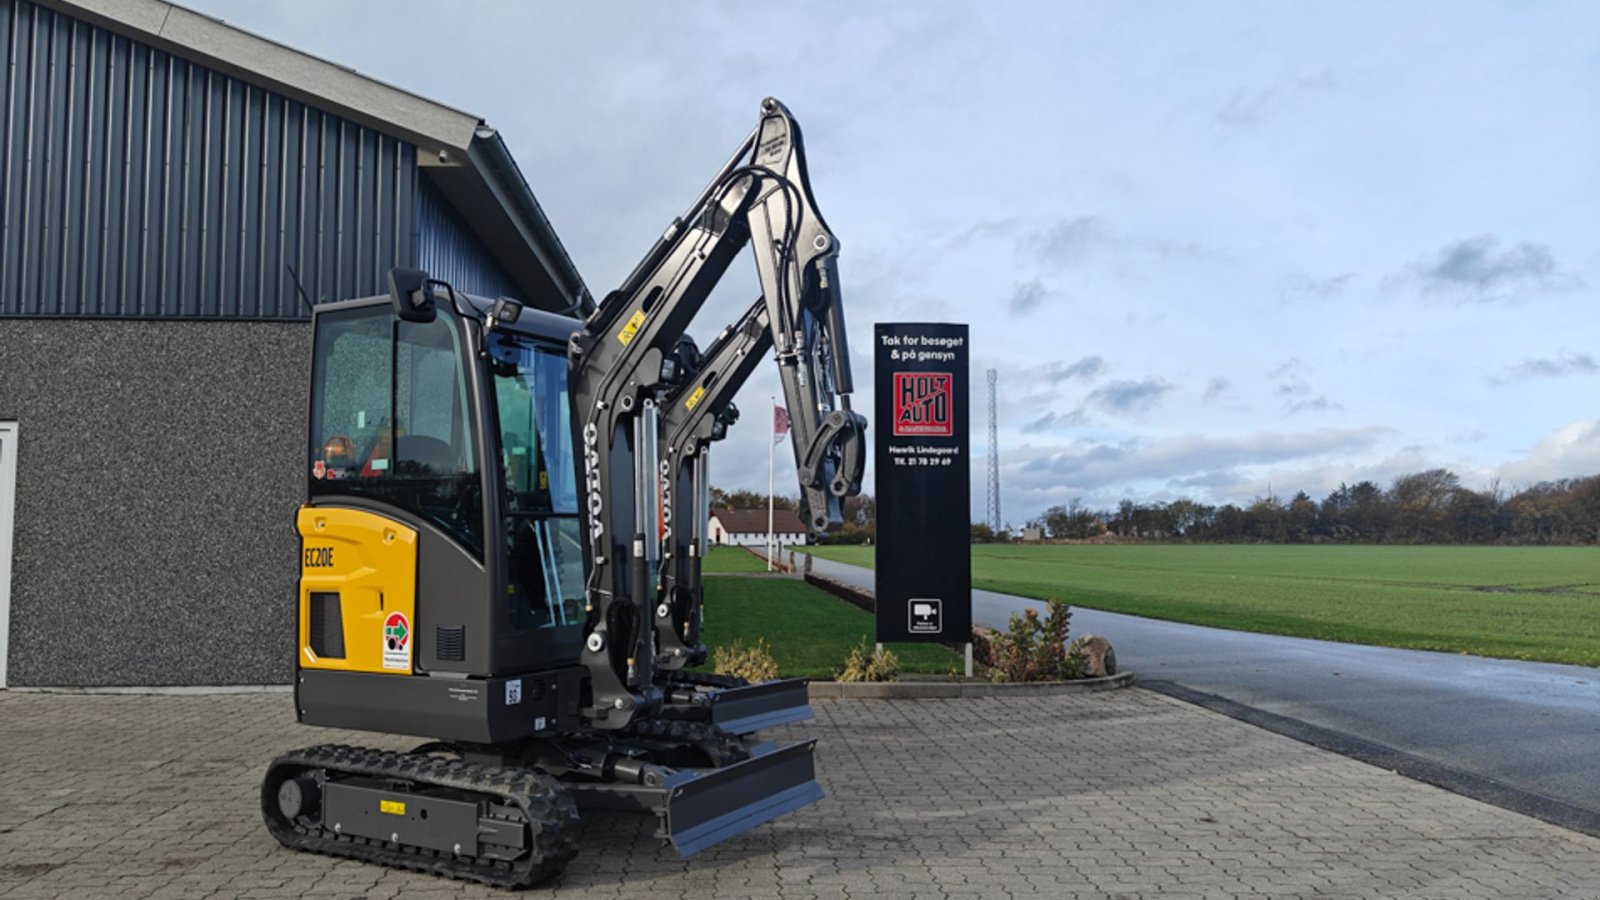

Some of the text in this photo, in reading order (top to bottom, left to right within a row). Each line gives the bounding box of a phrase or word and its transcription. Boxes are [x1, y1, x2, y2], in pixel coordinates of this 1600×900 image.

[881, 335, 963, 348] Tak for besøget
[890, 349, 955, 362] & på gensyn
[901, 377, 947, 407] HOLT
[900, 391, 947, 423] AUTO
[889, 446, 959, 456] Henrik Lindegaard
[583, 422, 604, 546] VOLVO
[304, 547, 334, 567] EC20E
